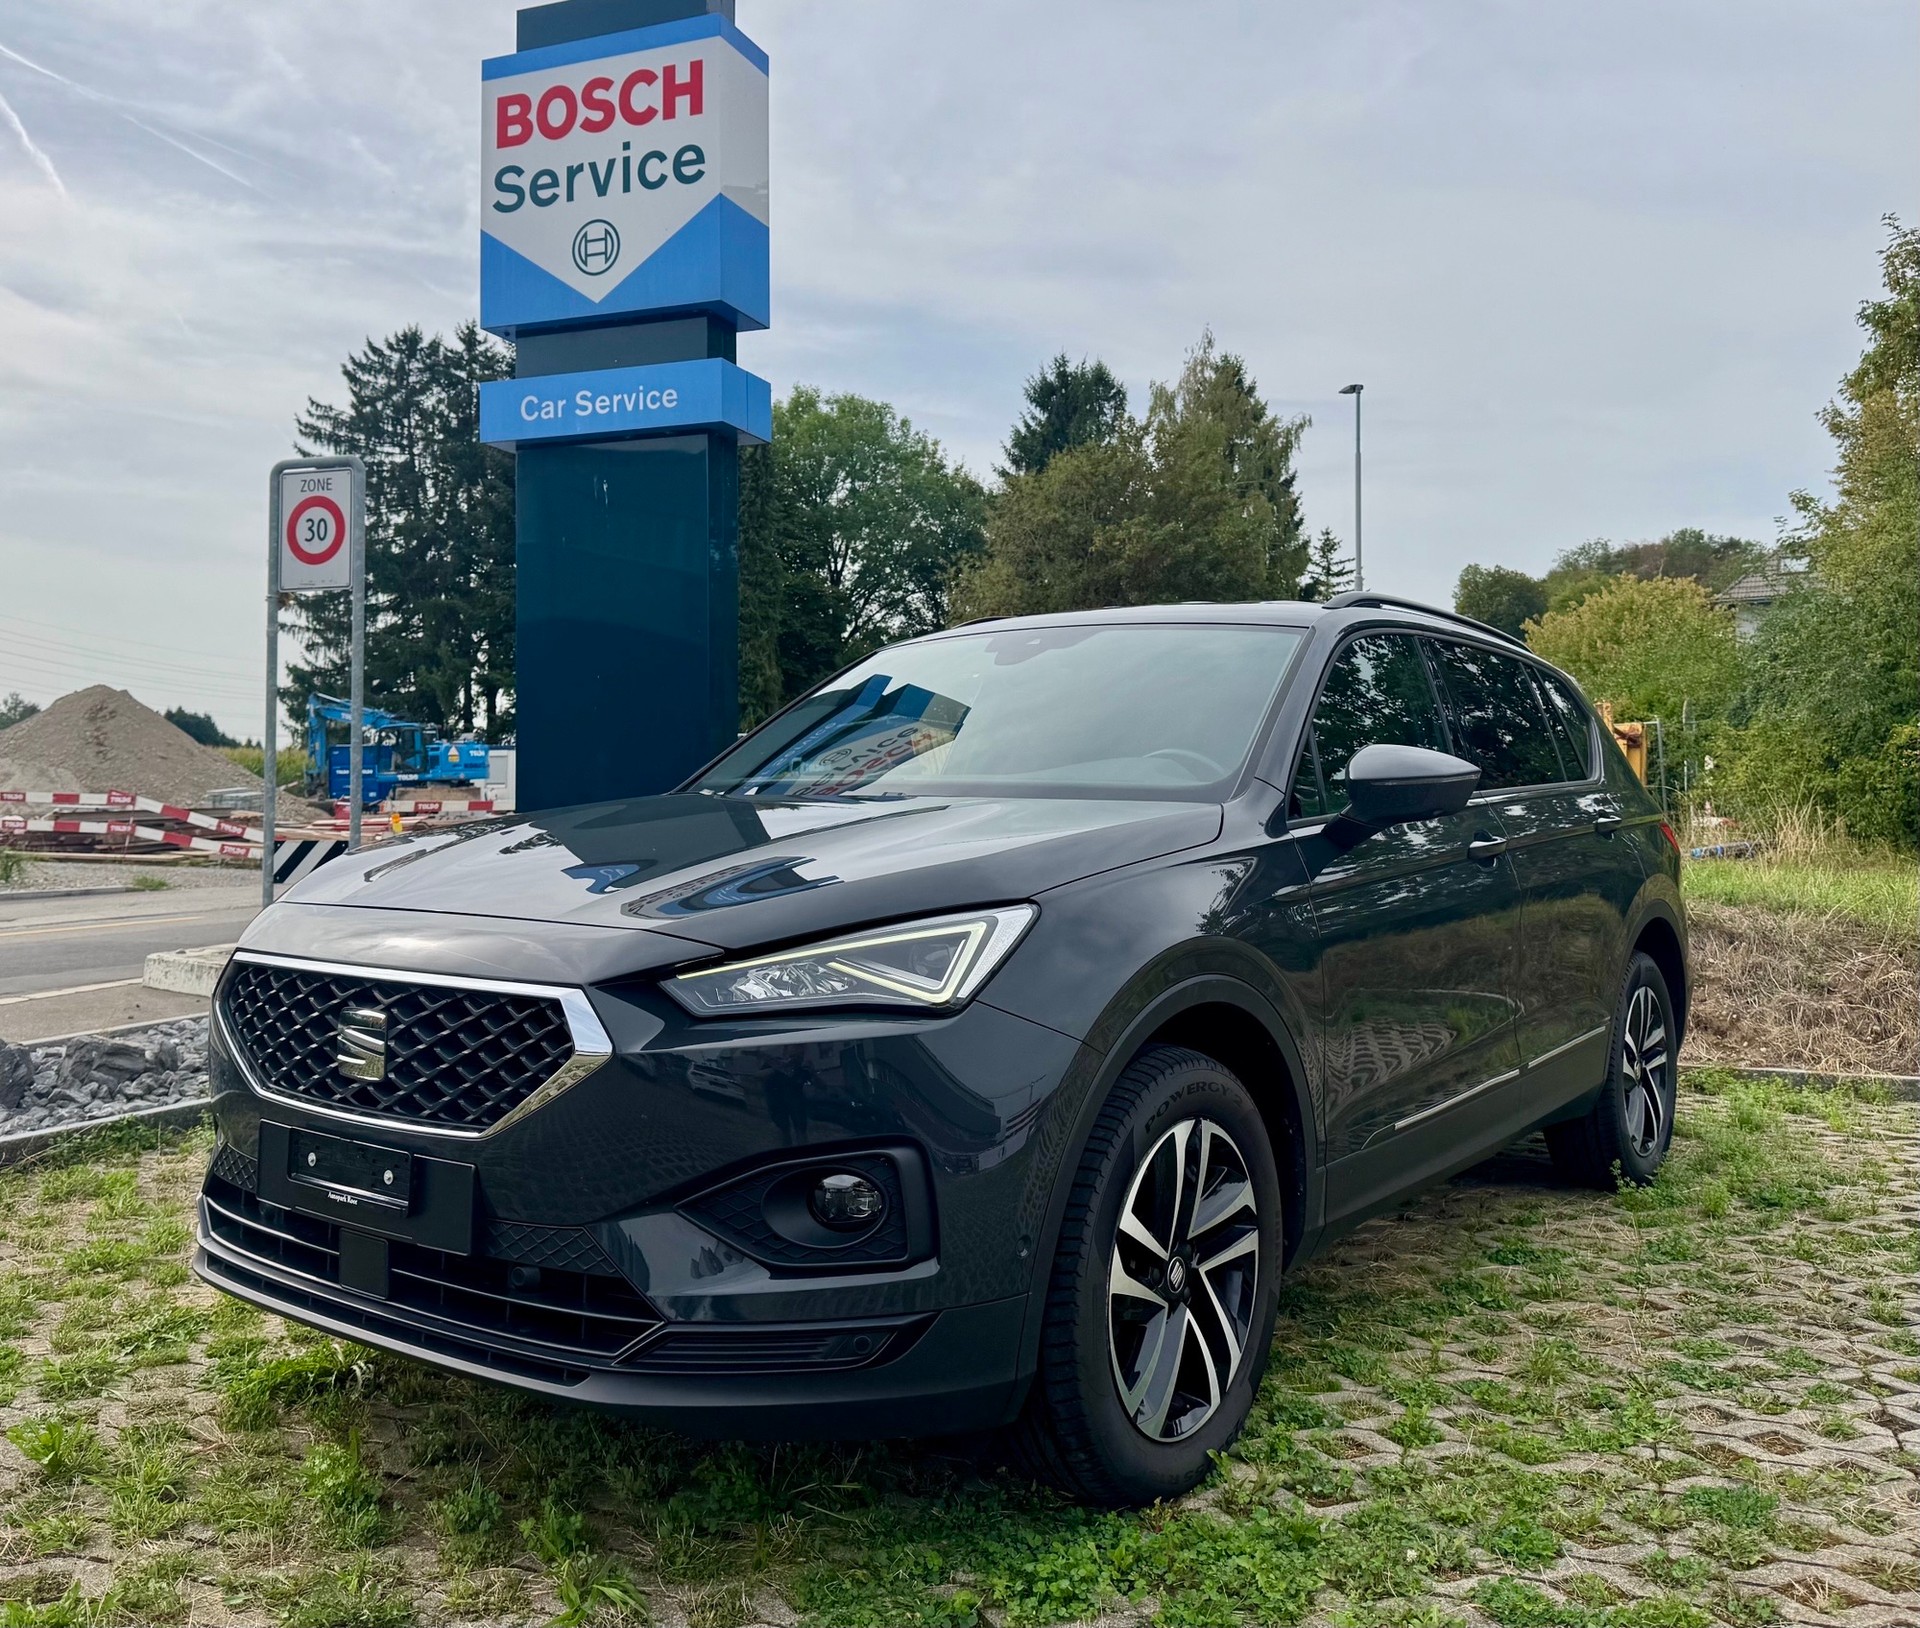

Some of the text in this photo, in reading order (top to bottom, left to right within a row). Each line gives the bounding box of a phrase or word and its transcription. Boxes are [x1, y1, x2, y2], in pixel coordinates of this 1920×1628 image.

[497, 59, 704, 149] BOSCH
[492, 141, 706, 213] Service
[520, 385, 678, 421] Car Service
[300, 478, 333, 493] ZONE
[304, 518, 328, 543] 30
[397, 773, 419, 781] TOLDO
[418, 802, 440, 810] TOLDO
